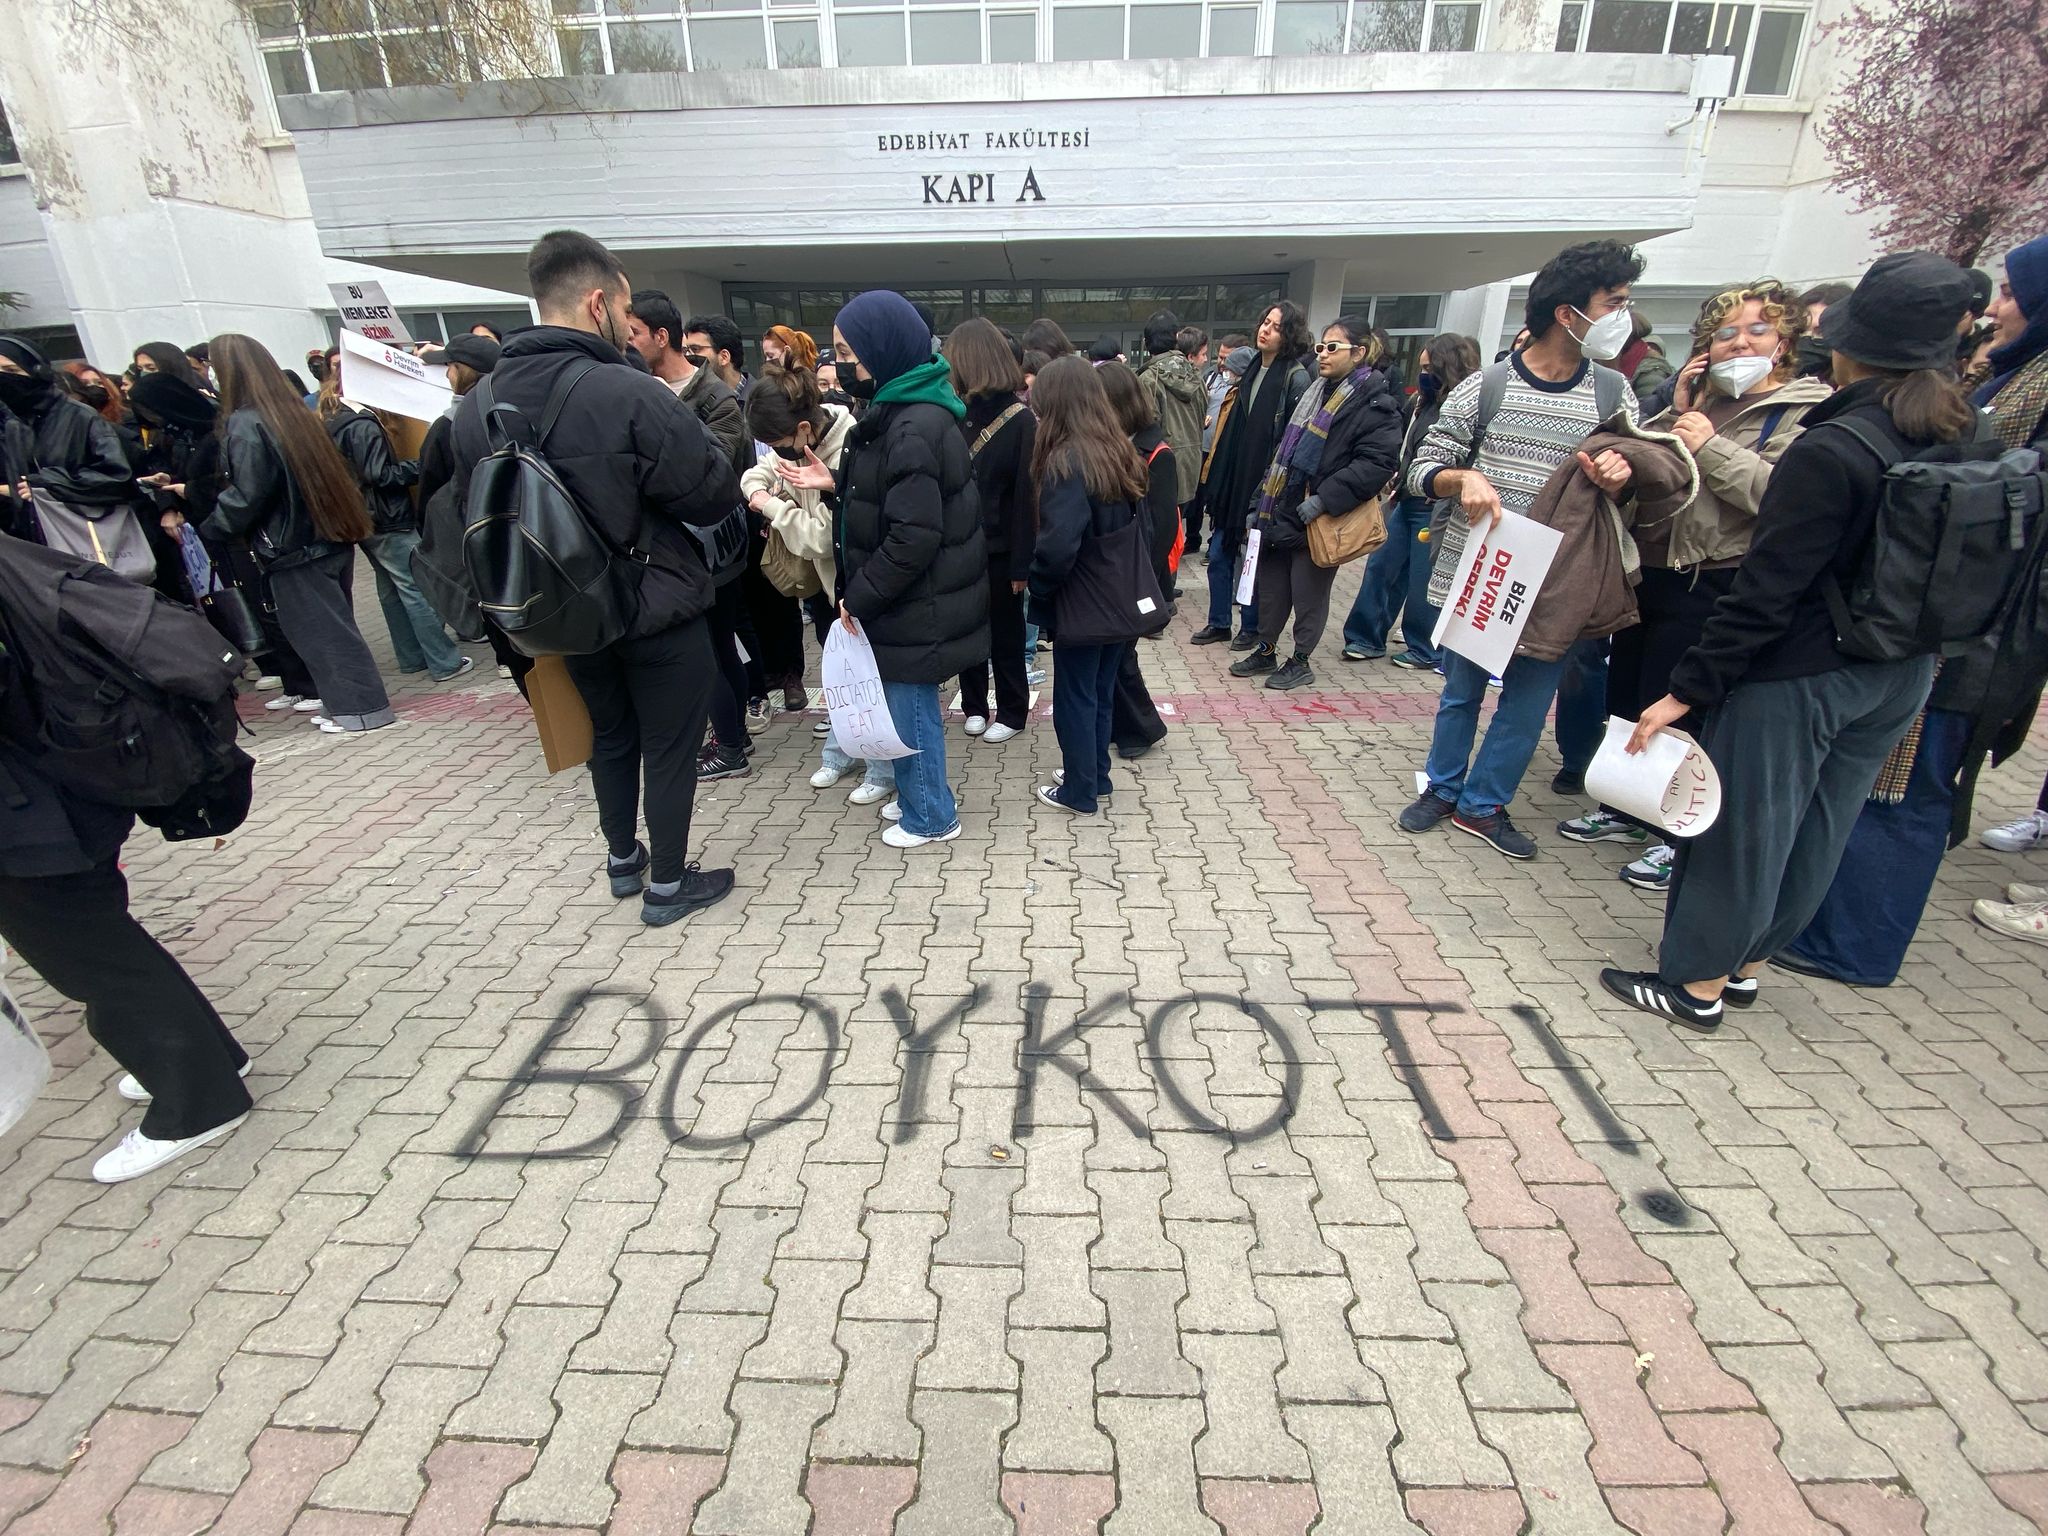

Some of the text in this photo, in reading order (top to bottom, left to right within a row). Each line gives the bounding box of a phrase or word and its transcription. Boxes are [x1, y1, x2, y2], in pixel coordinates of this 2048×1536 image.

[878, 127, 1090, 151] EDEBİYAT FAKÜLTESİ
[921, 165, 1046, 203] KAPI A
[347, 285, 363, 299] BU
[341, 305, 392, 320] MEMLEKET
[393, 351, 420, 369] Devrim
[393, 358, 425, 378] Hareketi
[1471, 548, 1513, 632] DEVRİM
[1499, 580, 1527, 626] BİZE
[844, 657, 855, 679] A
[847, 709, 876, 739] EAT
[1664, 752, 1708, 831] OLITICS
